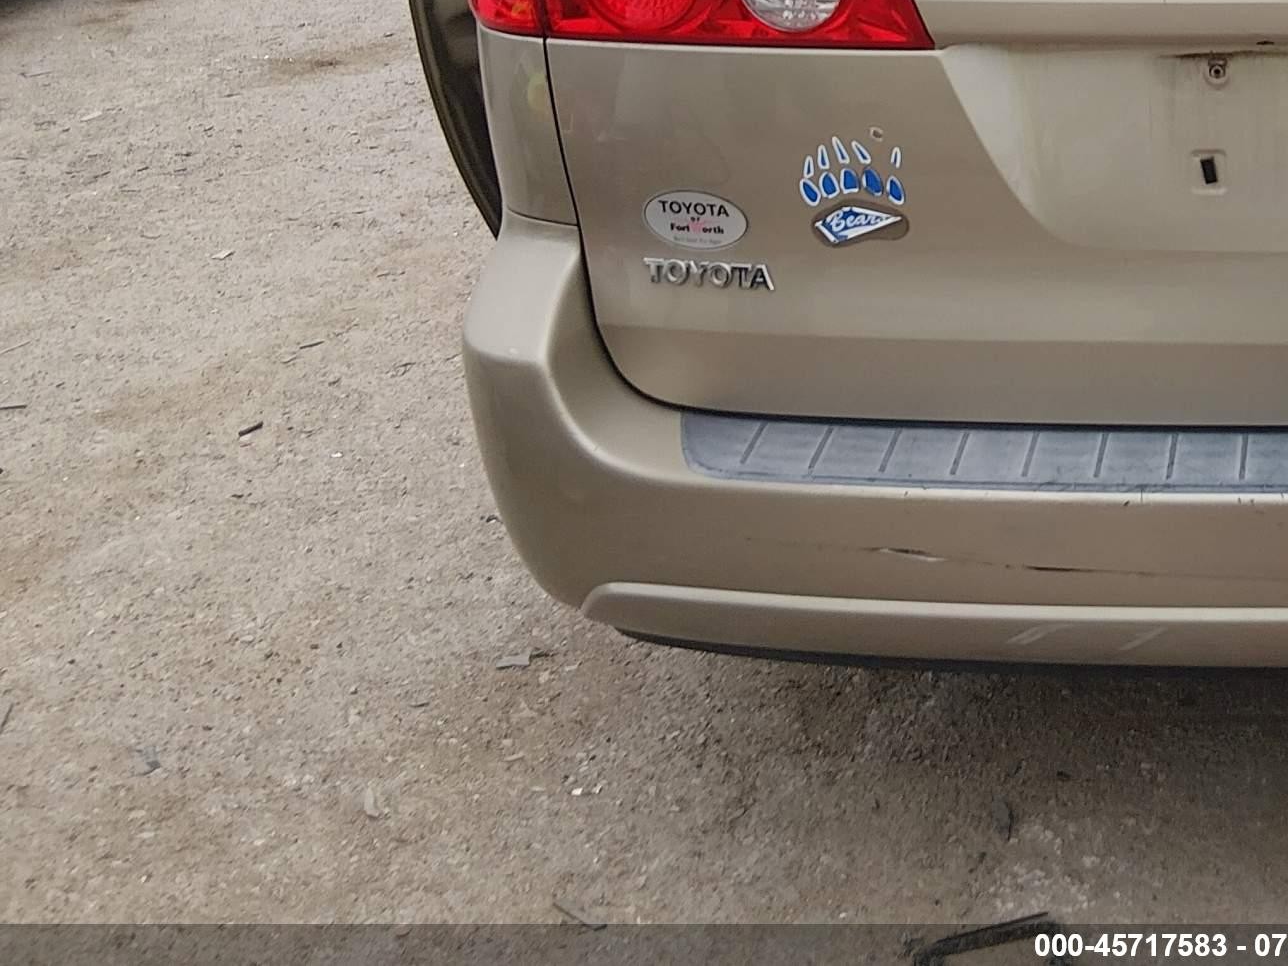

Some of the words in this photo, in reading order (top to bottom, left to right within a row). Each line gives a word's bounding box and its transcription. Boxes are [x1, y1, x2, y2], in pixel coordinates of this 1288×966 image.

[658, 199, 730, 218] TOYOTA
[670, 222, 691, 233] Fort
[643, 256, 775, 292] TOYOTA
